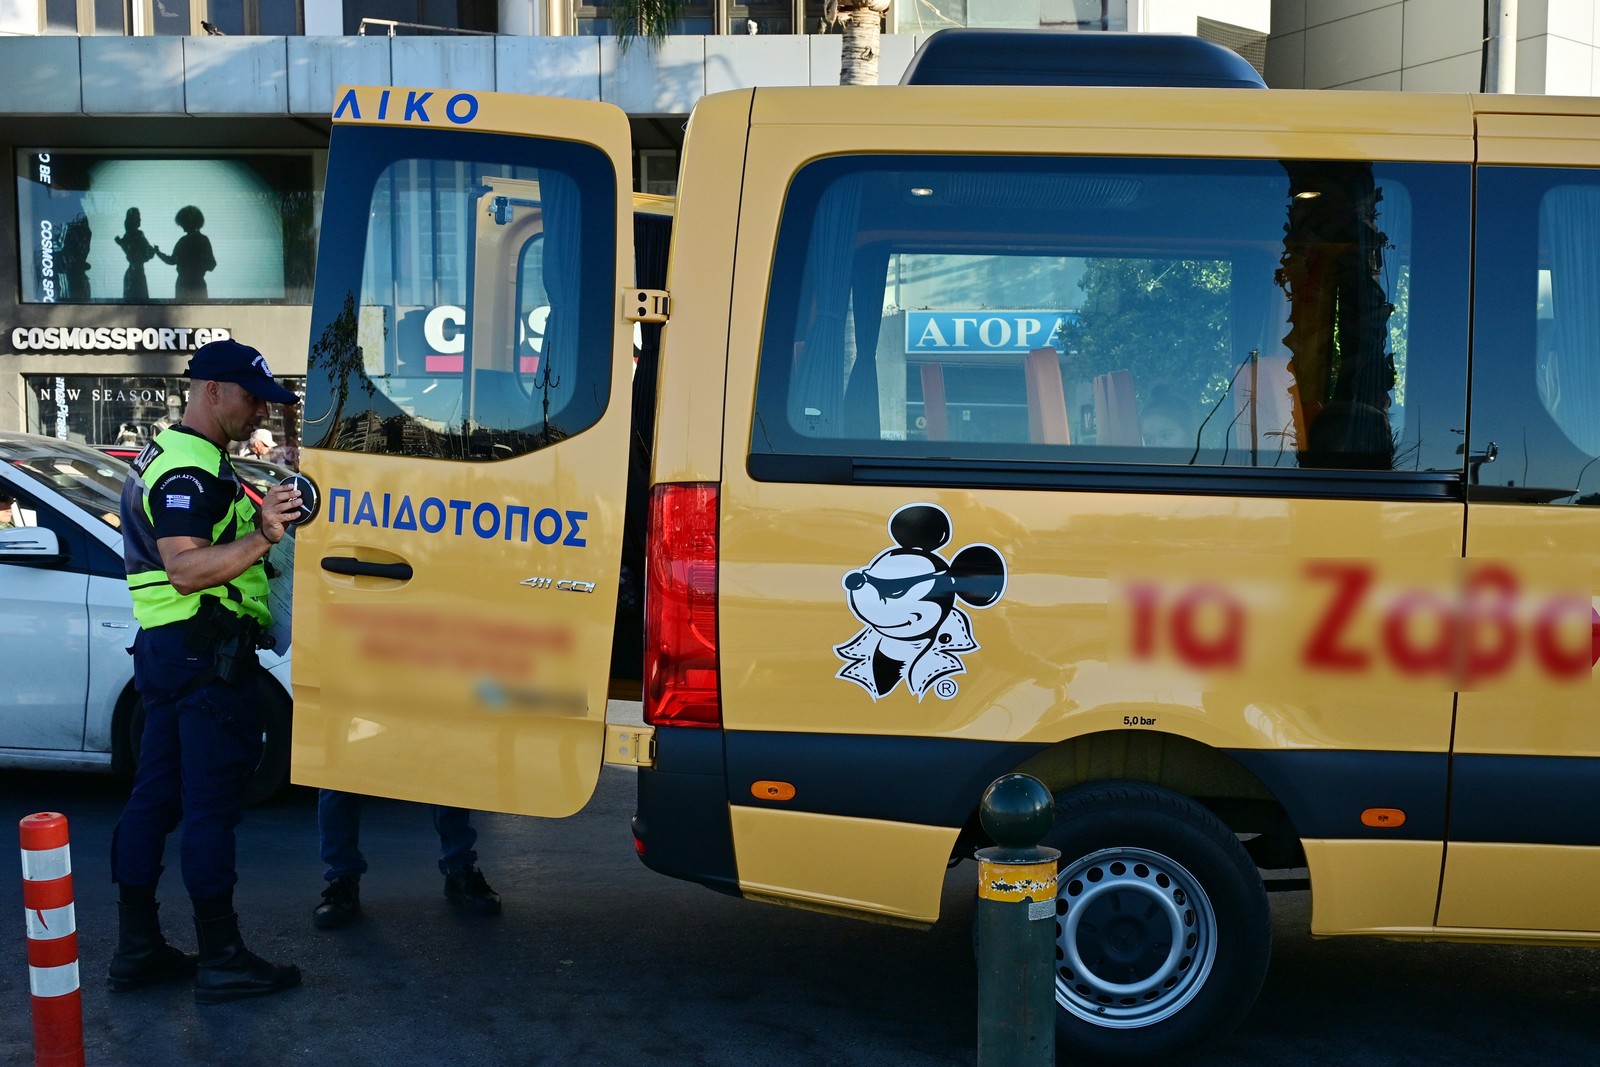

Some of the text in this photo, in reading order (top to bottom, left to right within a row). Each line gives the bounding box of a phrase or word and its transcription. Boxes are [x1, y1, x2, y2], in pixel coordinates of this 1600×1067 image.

[39, 164, 51, 184] BE
[41, 220, 54, 277] COSMOS
[92, 389, 165, 402] SEASON
[328, 487, 588, 548] ΠΑΙΔΟΤΟΠΟΣ
[519, 576, 597, 593] 411 CDI
[1123, 715, 1157, 727] 5,0 bar
